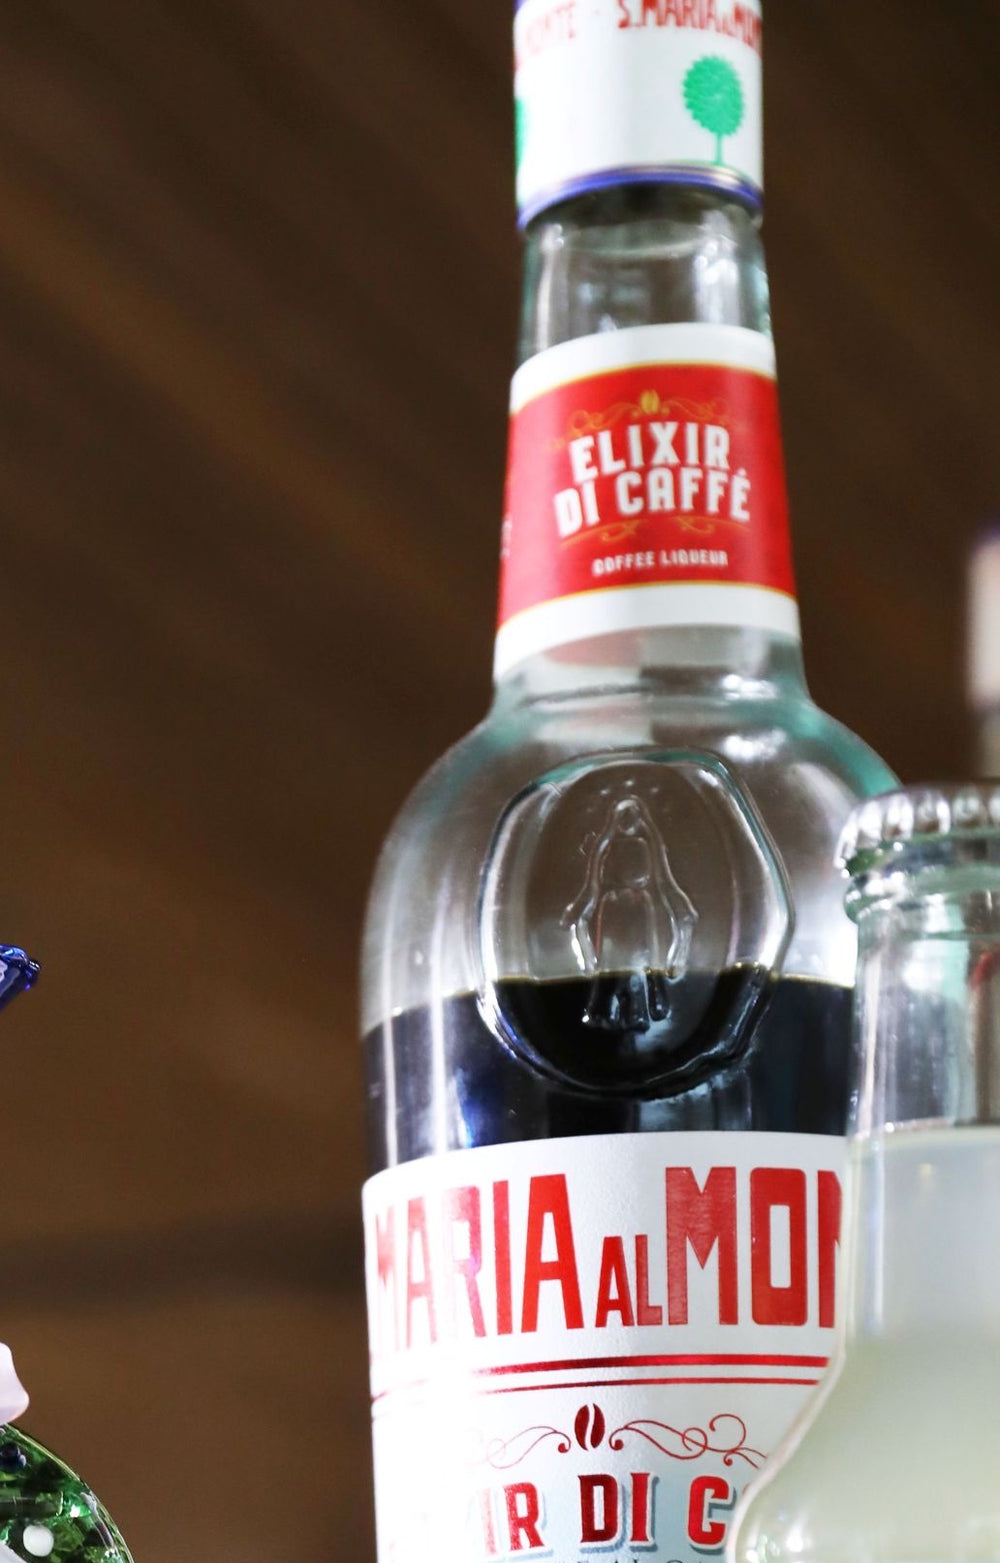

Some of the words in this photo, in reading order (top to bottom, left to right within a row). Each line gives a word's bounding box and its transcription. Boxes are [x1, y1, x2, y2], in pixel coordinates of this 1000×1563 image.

[568, 421, 731, 484] ELIXIR
[553, 479, 600, 538] DI
[592, 551, 655, 577] COFFEE
[660, 549, 728, 567] LIQUEUR
[376, 1172, 585, 1360] MARIA
[596, 1235, 662, 1327] AL
[578, 1472, 651, 1544] DI
